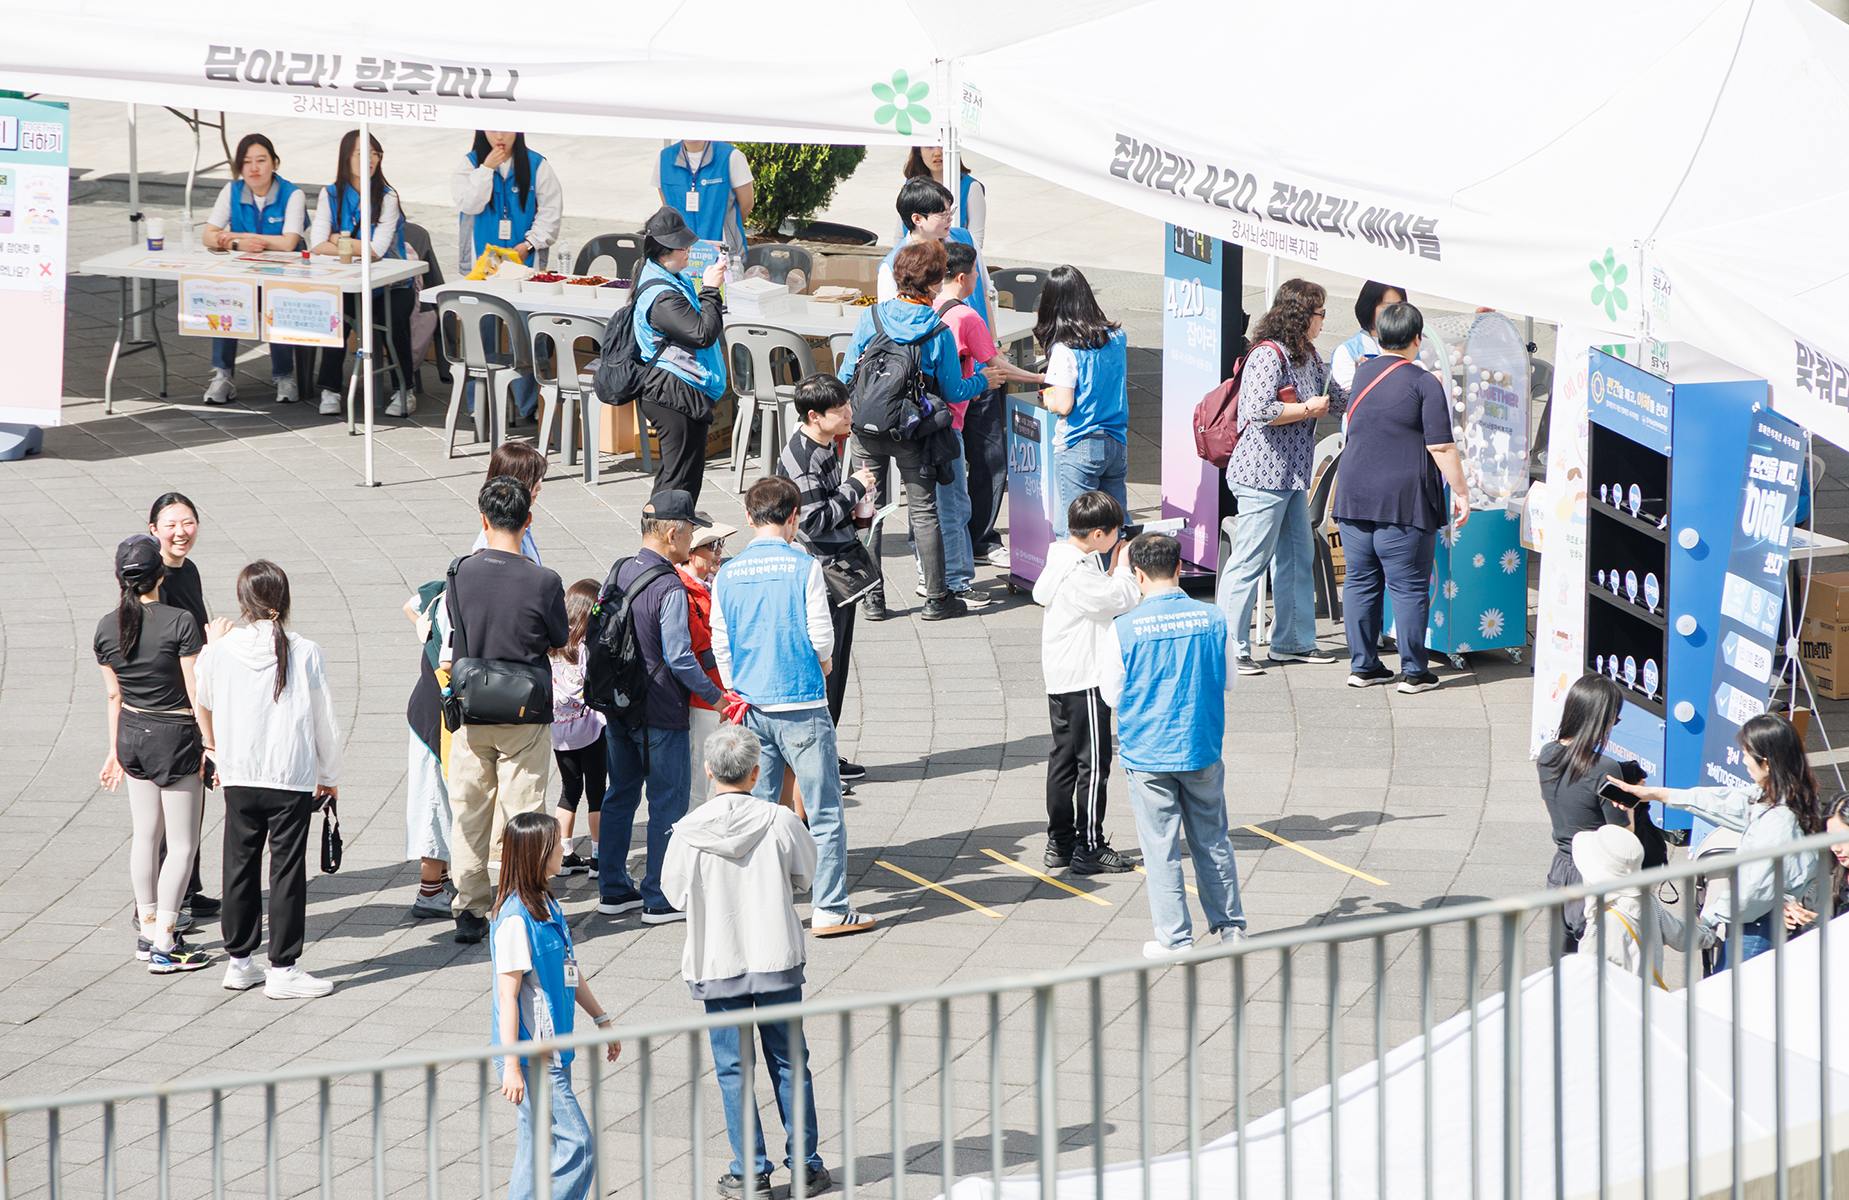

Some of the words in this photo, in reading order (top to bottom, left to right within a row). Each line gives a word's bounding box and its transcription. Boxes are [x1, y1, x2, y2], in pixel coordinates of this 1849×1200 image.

[205, 44, 342, 90] 담아라!
[353, 57, 520, 102] 향주머니
[292, 95, 438, 123] 강서뇌성마비복지관
[963, 88, 983, 108] 강서
[961, 101, 980, 122] 가치
[22, 122, 62, 132] TOGETHER
[22, 132, 61, 151] 더하기
[1109, 132, 1195, 198] 잡아라!
[1267, 180, 1357, 241] 잡아라!
[1358, 208, 1442, 262] 에어볼
[7, 242, 30, 254] 참여한
[33, 245, 41, 254] 후
[1230, 219, 1319, 261] 강서뇌성마비복지관
[1653, 274, 1671, 296] 강서
[1166, 277, 1204, 318] 4.20
[1187, 321, 1217, 355] 잡아라
[1606, 376, 1624, 400] 편견을
[1637, 391, 1655, 414] 이해를
[1009, 442, 1036, 473] 4.20
[1749, 453, 1779, 483] 편견을
[1741, 486, 1790, 548] 이해를
[726, 563, 796, 579] 강서뇌성마비복지관
[727, 559, 747, 569] 사단법인
[1132, 615, 1156, 625] 사단법인
[1133, 618, 1209, 636] 강서뇌성마비복지관
[1605, 740, 1640, 763] (TOGETHER)
[1726, 746, 1740, 765] 강서
